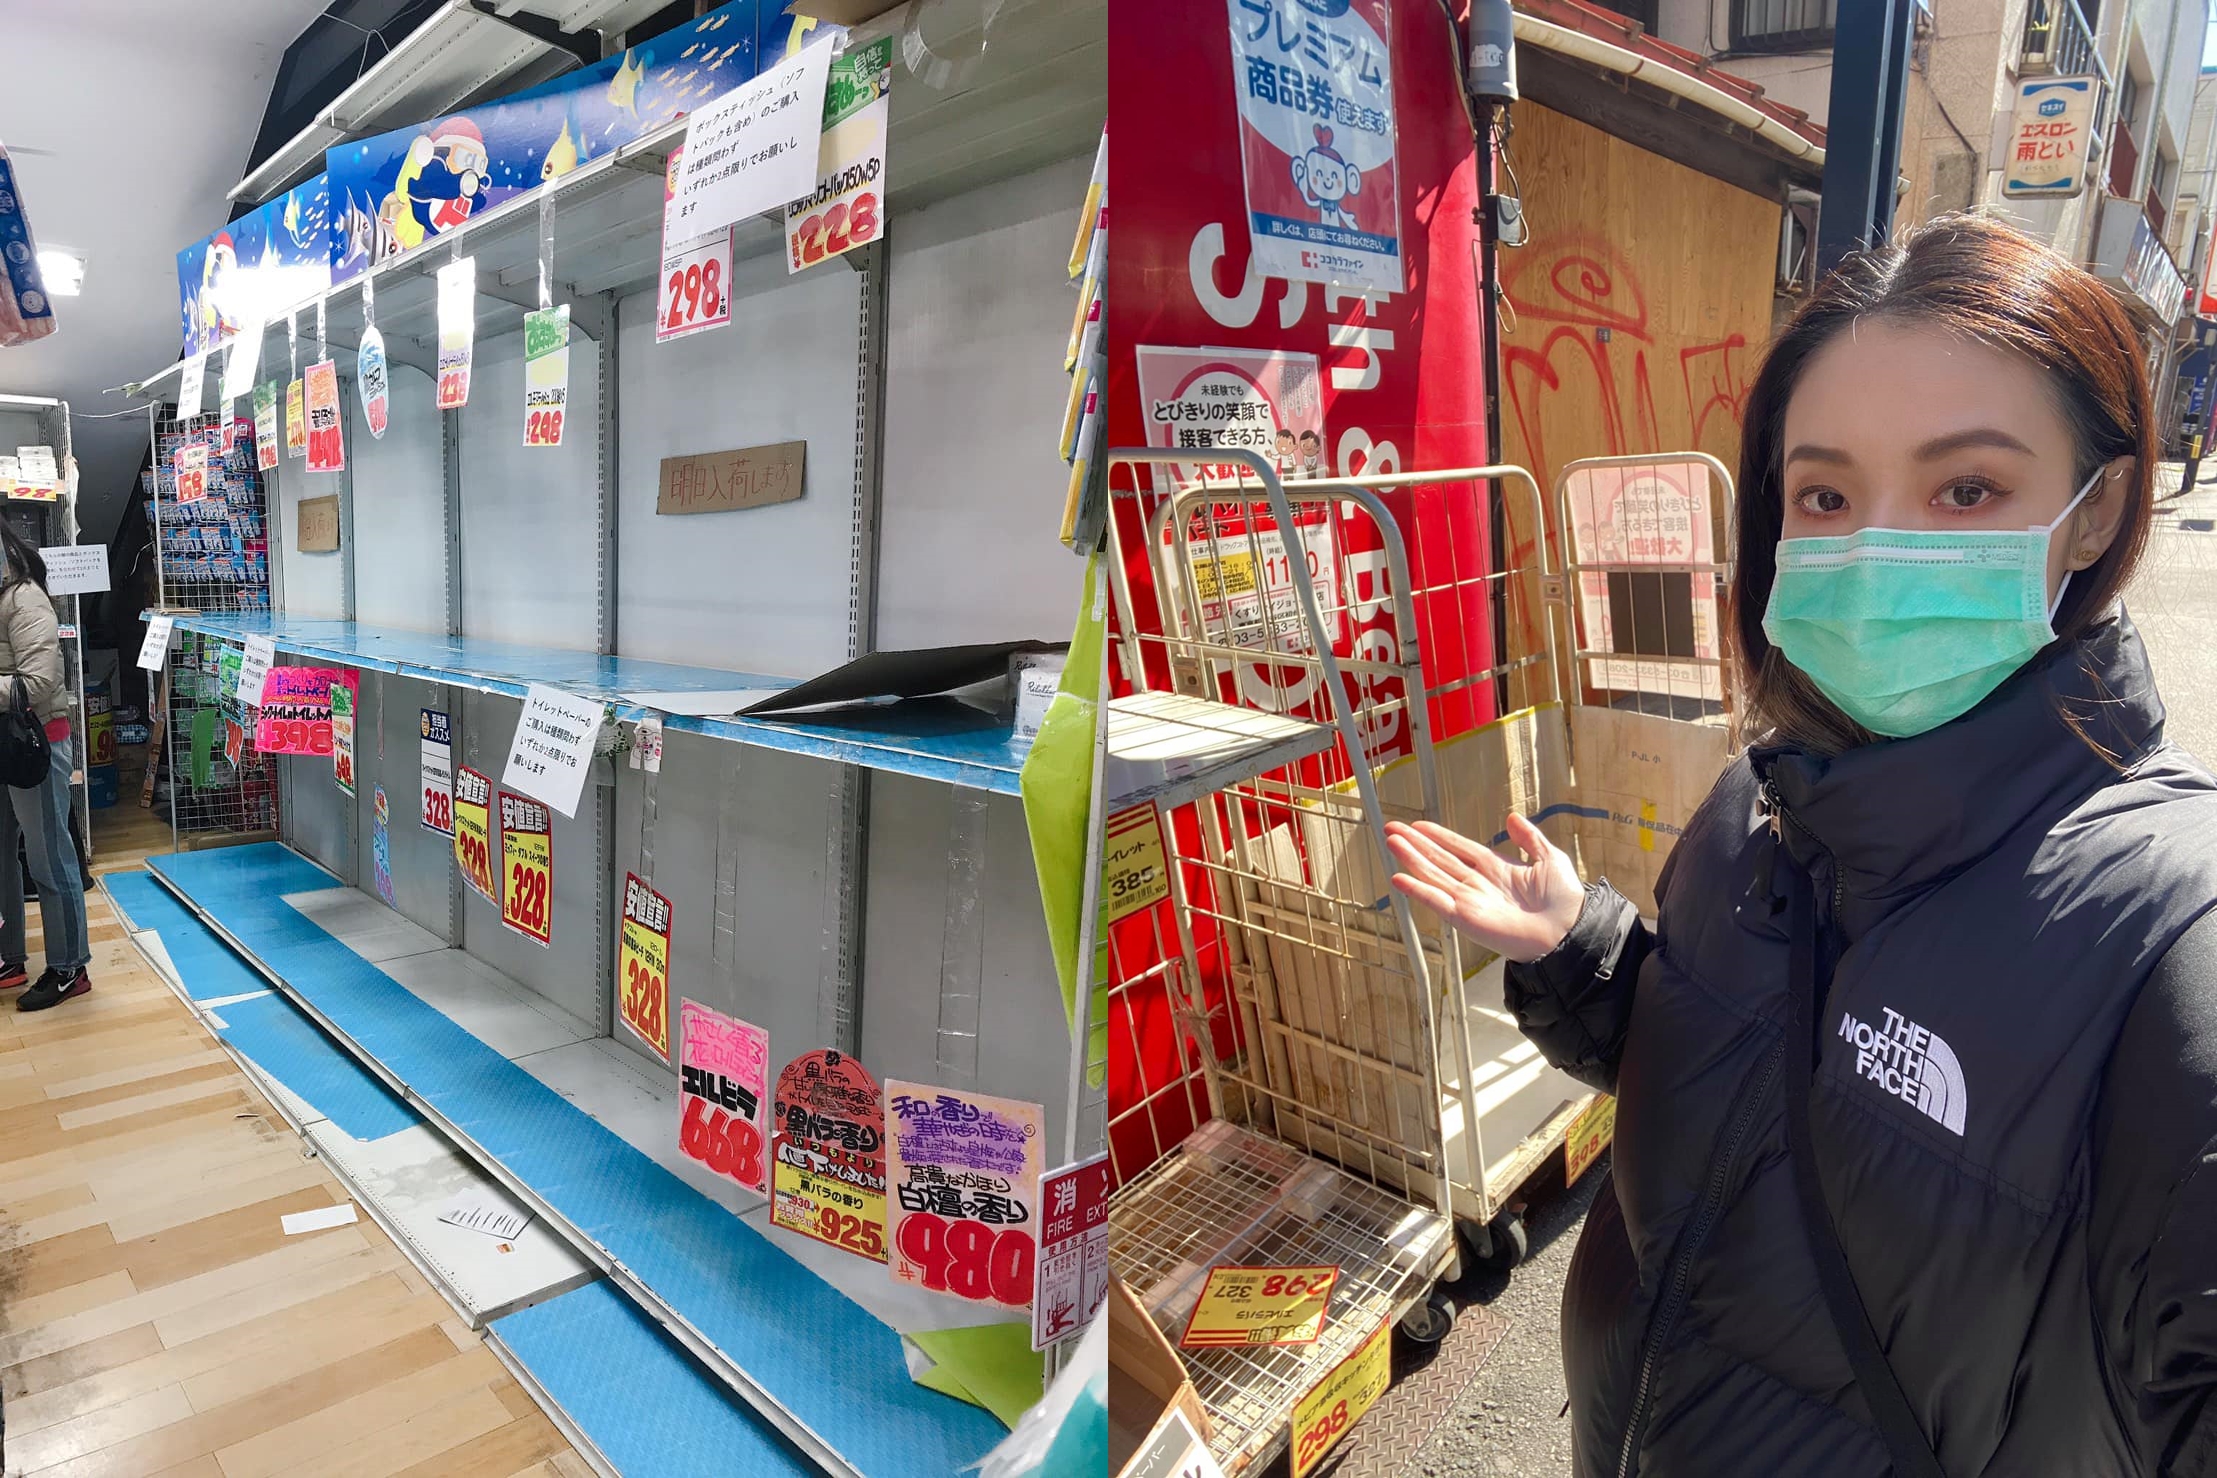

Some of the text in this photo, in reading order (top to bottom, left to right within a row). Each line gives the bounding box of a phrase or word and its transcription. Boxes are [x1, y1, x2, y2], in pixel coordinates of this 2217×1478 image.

[1240, 0, 1383, 88] プレミアム
[1246, 55, 1388, 135] 商品券 使えます
[2017, 140, 2074, 160] 雨とい
[2021, 123, 2077, 137] エスロン
[687, 140, 740, 176] は種類問わず
[680, 201, 697, 218] ます
[799, 192, 878, 264] 228
[667, 258, 721, 328] 298
[1154, 401, 1269, 422] とびきりの笑顔で
[1201, 384, 1244, 398] 未経験でも
[671, 458, 794, 506] 明日入荷します
[525, 717, 581, 746] ご購入は種類問わず
[532, 698, 592, 728] トイレットペーパーの
[271, 721, 335, 755] 398
[513, 753, 546, 776] 願いします
[425, 787, 449, 829] 328
[459, 830, 488, 892] 328
[1112, 865, 1154, 897] 385
[511, 862, 547, 931] 328
[627, 958, 662, 1042] 328
[1838, 1012, 1924, 1083] NORTH
[1883, 1006, 1930, 1054] THE
[682, 1064, 758, 1120] エルビラ
[1856, 1049, 1920, 1107] FACE
[681, 1095, 761, 1186] 668
[785, 1104, 879, 1152] 黒バラの香り
[800, 1179, 864, 1210] 黒バラの香り
[821, 1207, 883, 1257] 925
[1047, 1216, 1073, 1240] FIRE
[896, 1212, 1036, 1306] 980
[1214, 1285, 1252, 1298] 327
[1261, 1273, 1333, 1297] 298
[1298, 1399, 1348, 1471] 298
